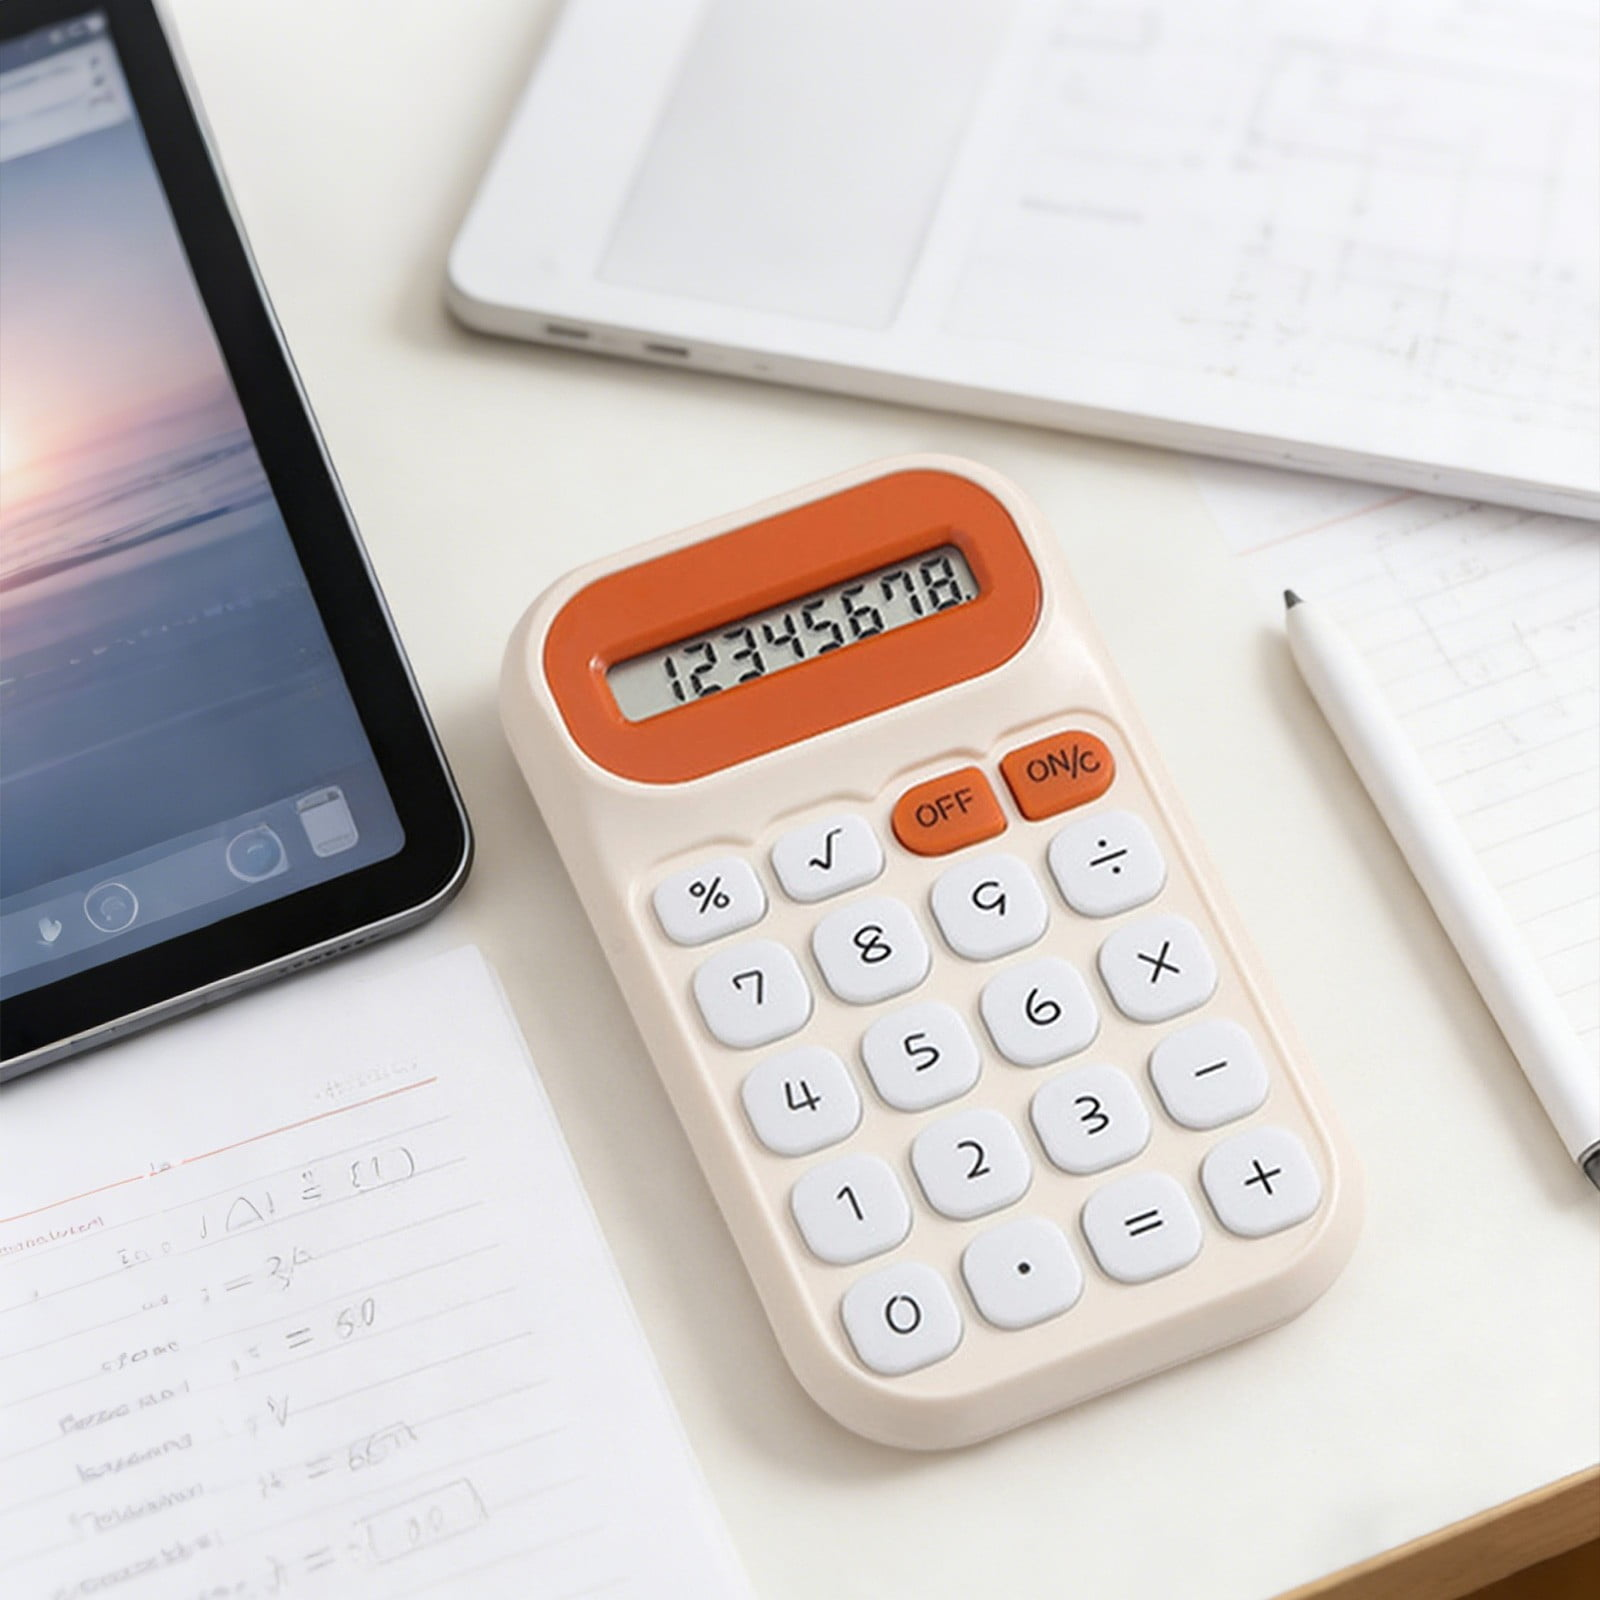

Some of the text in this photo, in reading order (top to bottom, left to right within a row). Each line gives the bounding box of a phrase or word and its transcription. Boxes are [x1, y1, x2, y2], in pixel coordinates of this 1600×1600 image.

[1027, 745, 1100, 783] ON/C
[915, 789, 974, 828] OFF
[689, 876, 731, 914] %
[972, 881, 1006, 916] 9
[853, 925, 892, 964] 8
[732, 970, 764, 1005] 7
[1025, 988, 1062, 1026] 6
[903, 1033, 940, 1072] 5
[784, 1080, 821, 1111] 4
[1074, 1096, 1110, 1135] 3
[957, 1140, 990, 1179] 2
[1244, 1159, 1281, 1195] +
[836, 1185, 864, 1221] 1
[1124, 1209, 1163, 1237] =
[885, 1295, 921, 1335] 0
